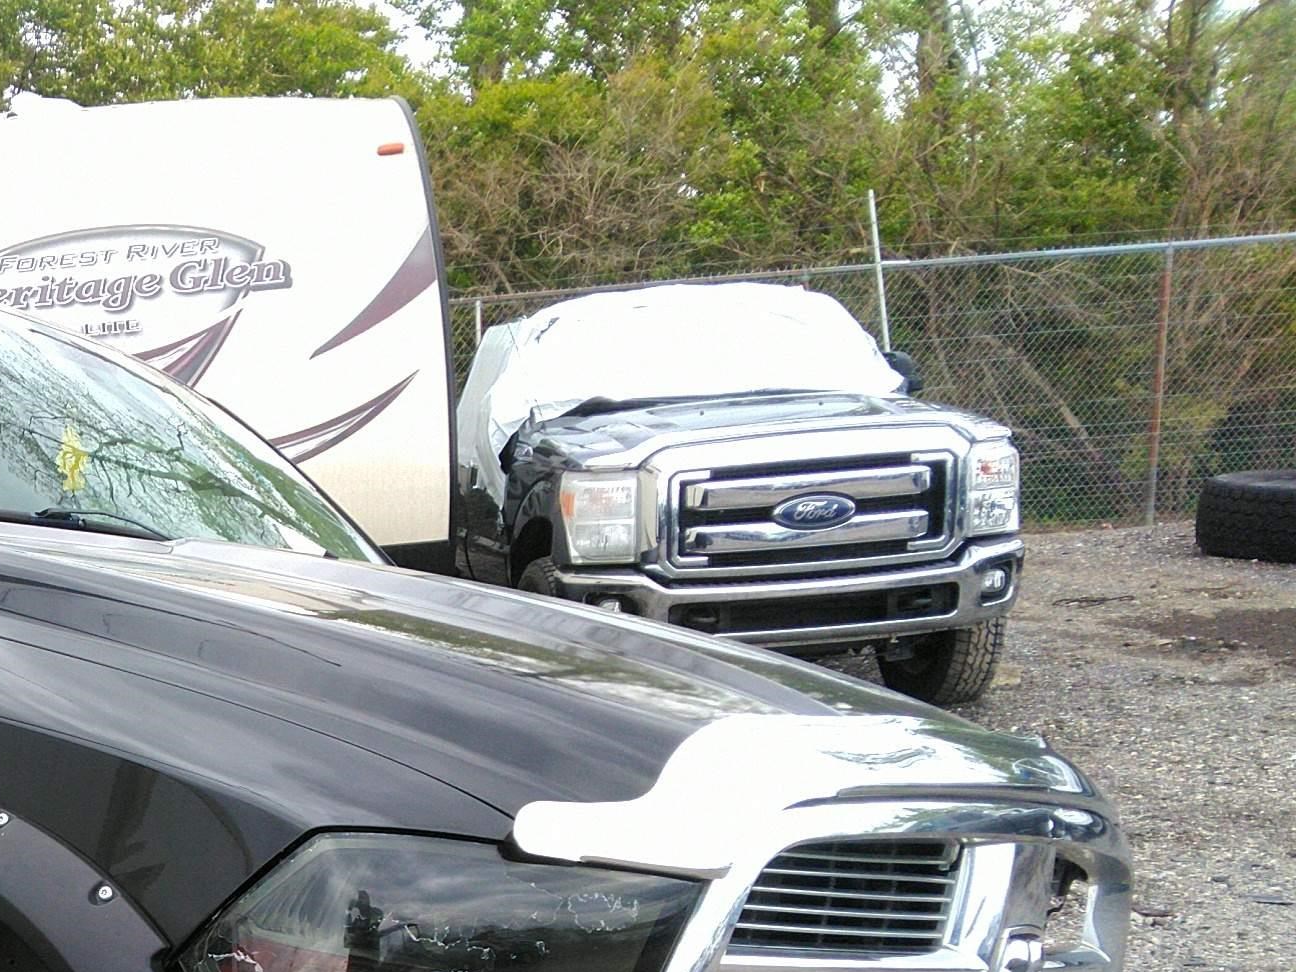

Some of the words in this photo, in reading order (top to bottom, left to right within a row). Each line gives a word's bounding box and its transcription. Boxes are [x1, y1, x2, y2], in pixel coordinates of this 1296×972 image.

[126, 237, 221, 261] RIVER
[169, 257, 293, 294] Glen
[793, 500, 839, 521] Ford
